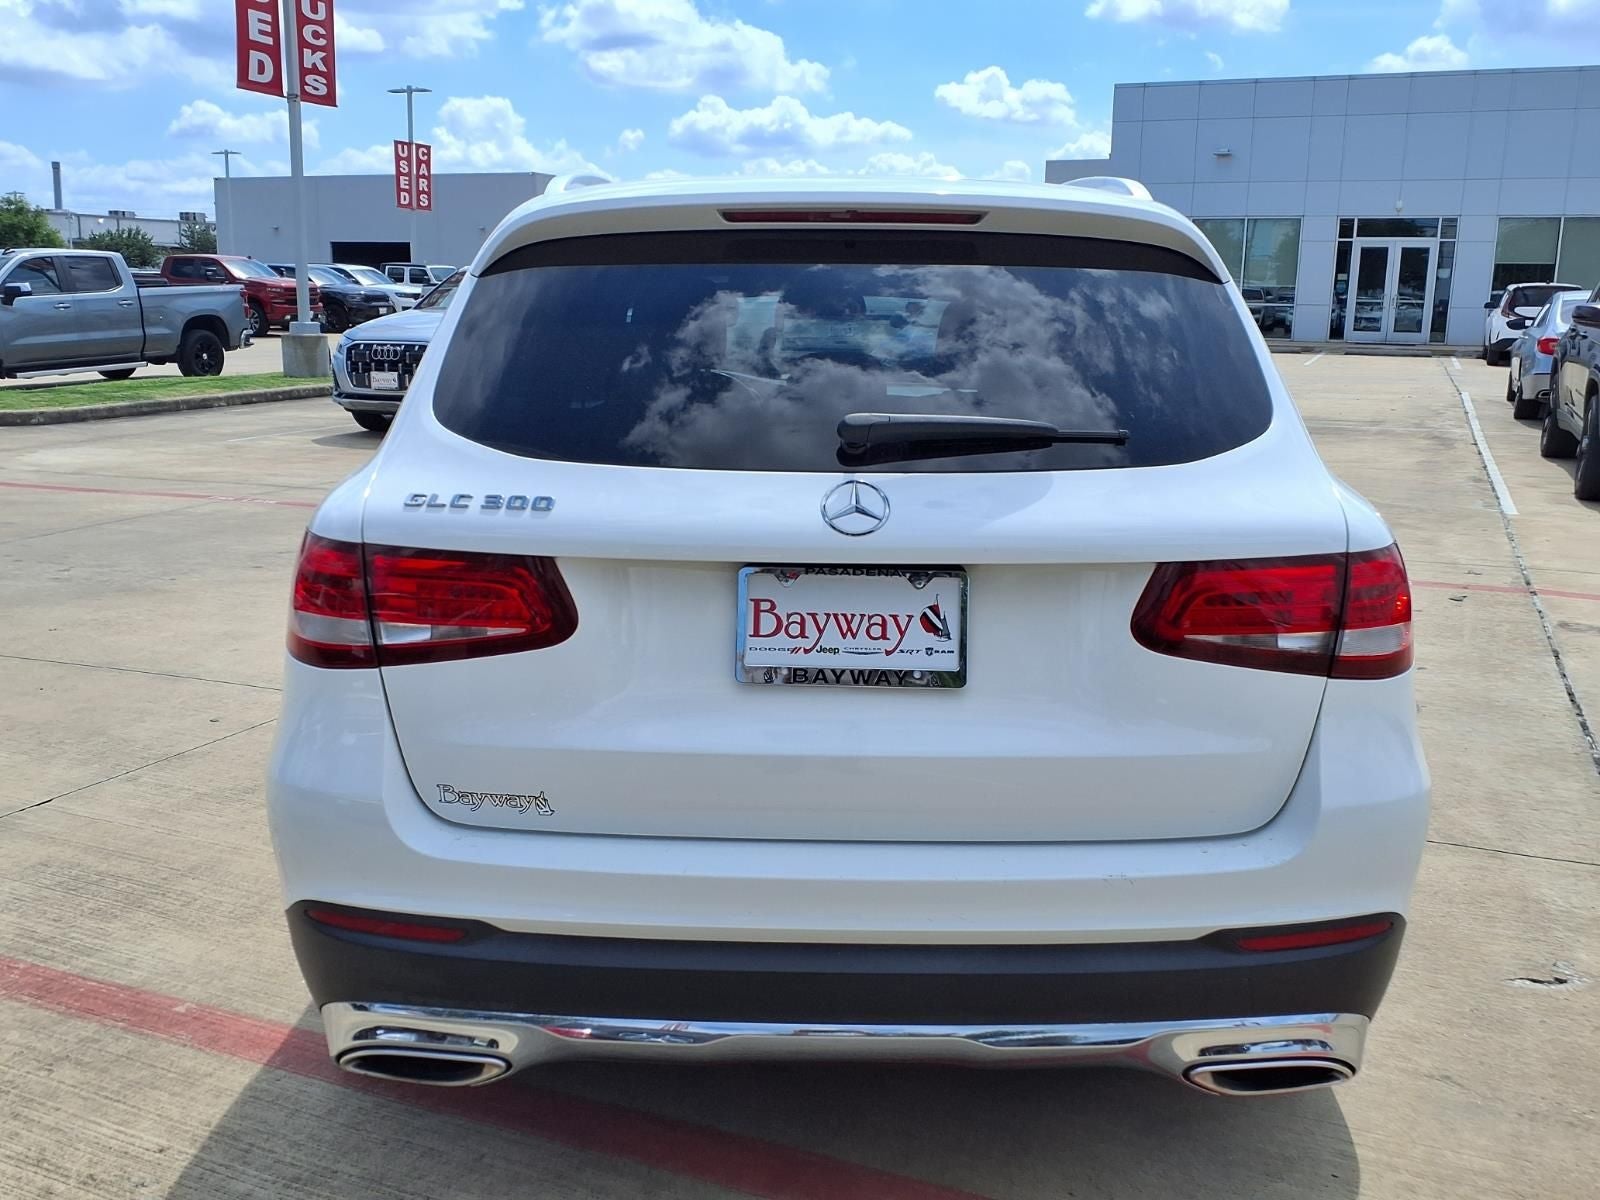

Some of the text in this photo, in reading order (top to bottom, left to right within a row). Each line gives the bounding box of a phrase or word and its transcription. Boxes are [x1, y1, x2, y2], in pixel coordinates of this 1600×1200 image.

[247, 0, 274, 83] ED
[398, 144, 410, 205] USED
[418, 147, 429, 207] CARS
[403, 493, 556, 511] GLC 300
[749, 598, 914, 656] Bayway
[815, 645, 840, 655] Jeep
[793, 668, 906, 686] BAYWAY
[436, 783, 536, 815] Bayway
